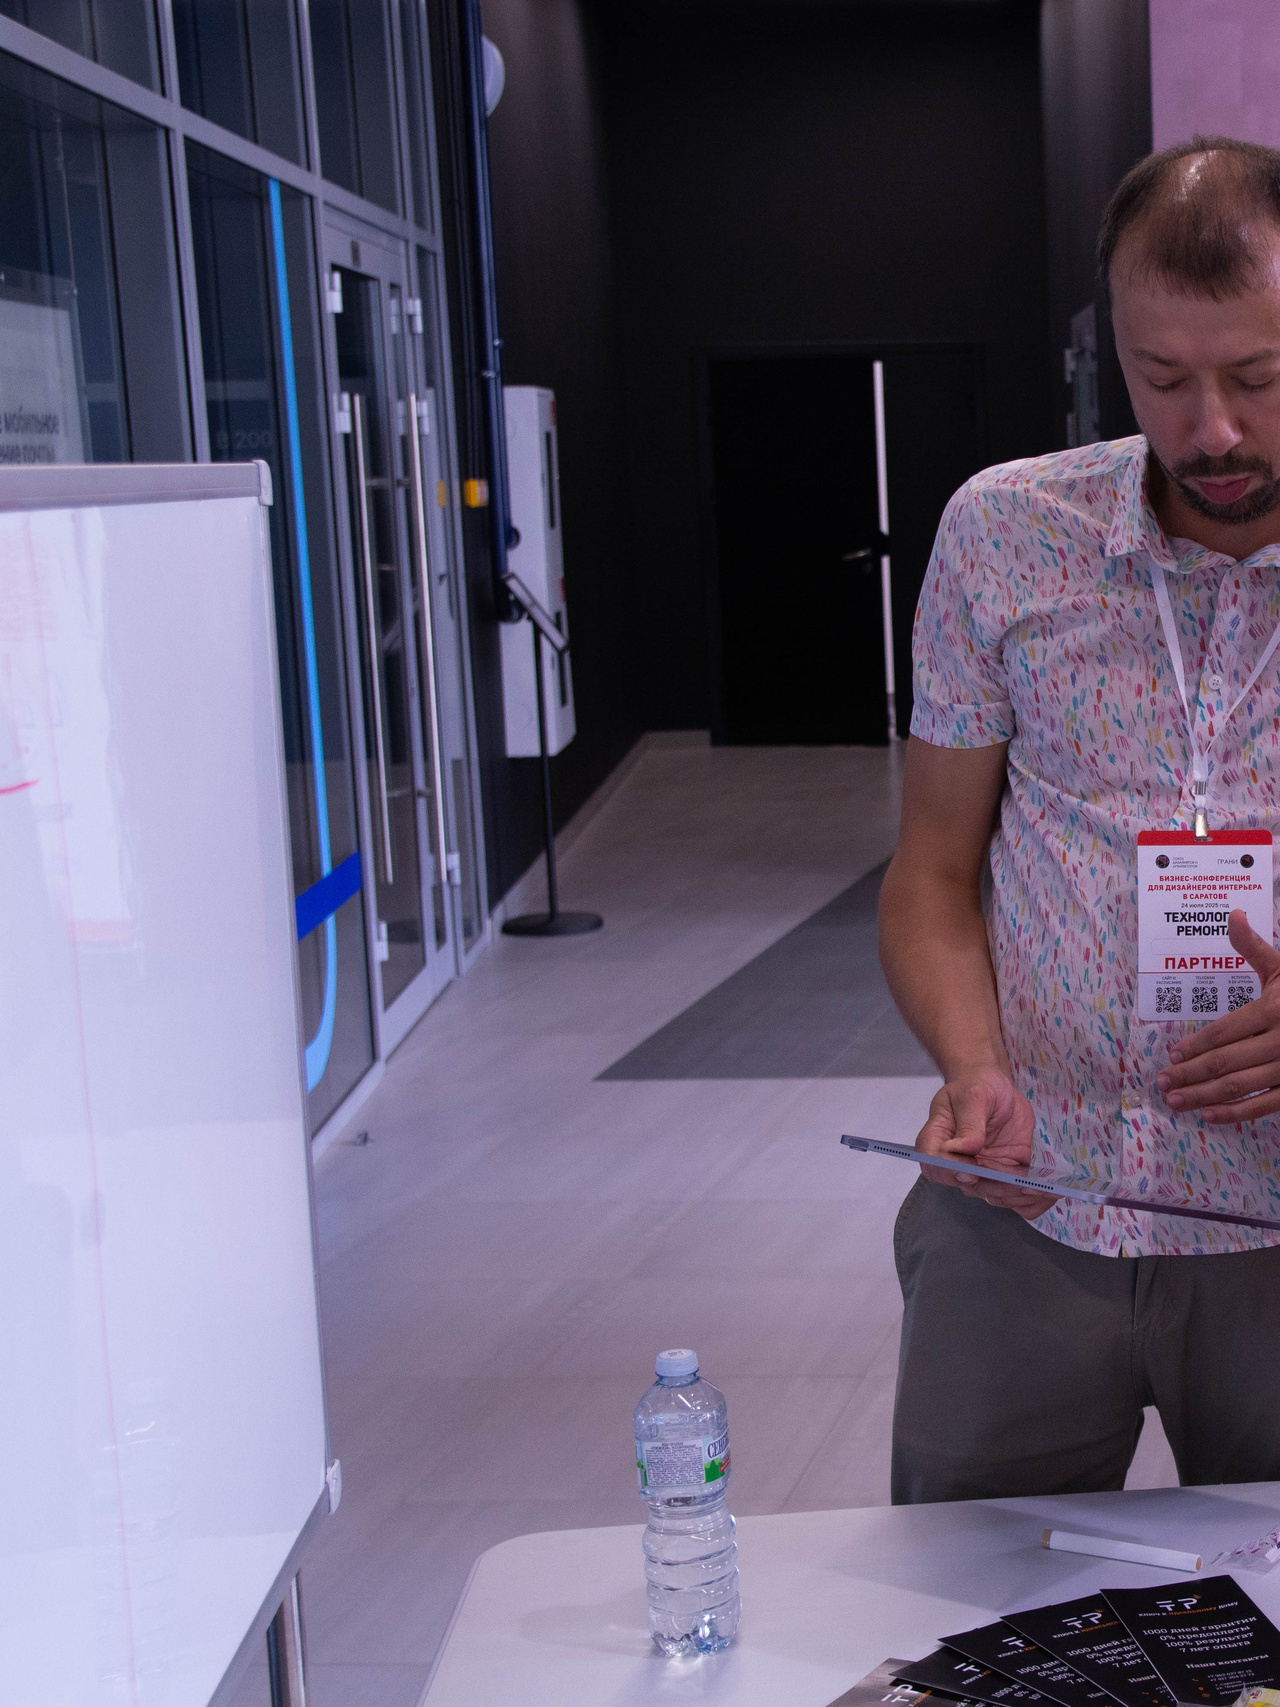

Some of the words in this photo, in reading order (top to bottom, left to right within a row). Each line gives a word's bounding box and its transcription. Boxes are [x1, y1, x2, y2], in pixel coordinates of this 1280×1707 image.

[1165, 883, 1217, 891] ДИЗАЙНЕРОВ
[1164, 912, 1246, 922] ТЕХНОЛОГ
[1164, 957, 1245, 969] ПАРТНЕР
[1218, 1601, 1239, 1610] дому
[1142, 1627, 1169, 1636] 1000
[1170, 1624, 1199, 1635] дней
[1201, 1616, 1257, 1631] гарантии
[1160, 1633, 1176, 1641] 0%
[1178, 1625, 1251, 1641] предоплаты
[1165, 1640, 1193, 1648] 100%
[1195, 1632, 1254, 1647] результат
[1067, 1647, 1092, 1657] 1000
[1093, 1640, 1121, 1652] дней
[1105, 1644, 1138, 1656] предо
[1190, 1645, 1210, 1653] лет
[1213, 1640, 1251, 1651] опыта
[1096, 1655, 1122, 1665] 100%
[1123, 1658, 1142, 1667] лет
[1186, 1661, 1216, 1669] Наши
[1217, 1653, 1270, 1667] контакты
[1016, 1665, 1041, 1675] 1000
[1037, 1669, 1053, 1677] 0%
[1049, 1672, 1075, 1682] 100%
[1128, 1674, 1157, 1683] Наши
